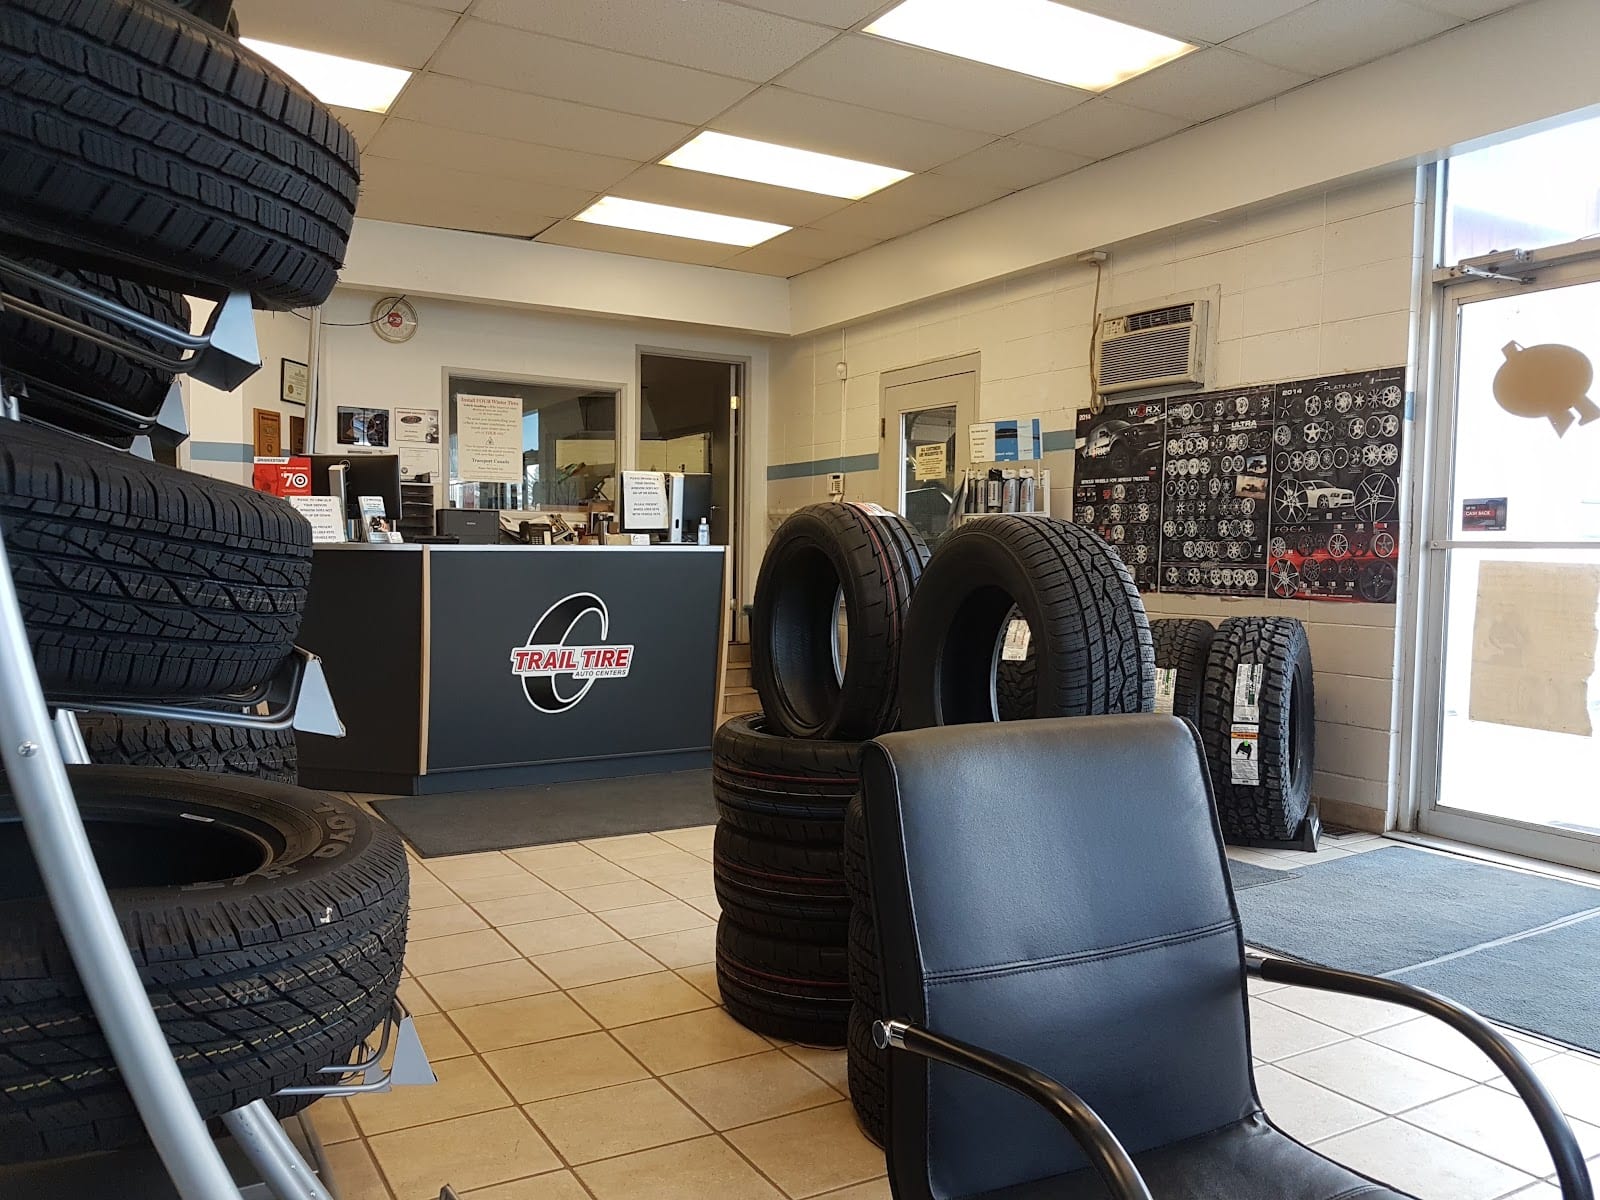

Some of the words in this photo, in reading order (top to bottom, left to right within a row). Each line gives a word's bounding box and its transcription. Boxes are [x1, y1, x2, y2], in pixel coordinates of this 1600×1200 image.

[1324, 382, 1362, 390] PLATINUM
[1231, 420, 1257, 430] ULTRA
[1275, 525, 1312, 533] FOCAL
[514, 650, 578, 671] TRAIL
[582, 648, 630, 668] TIRE
